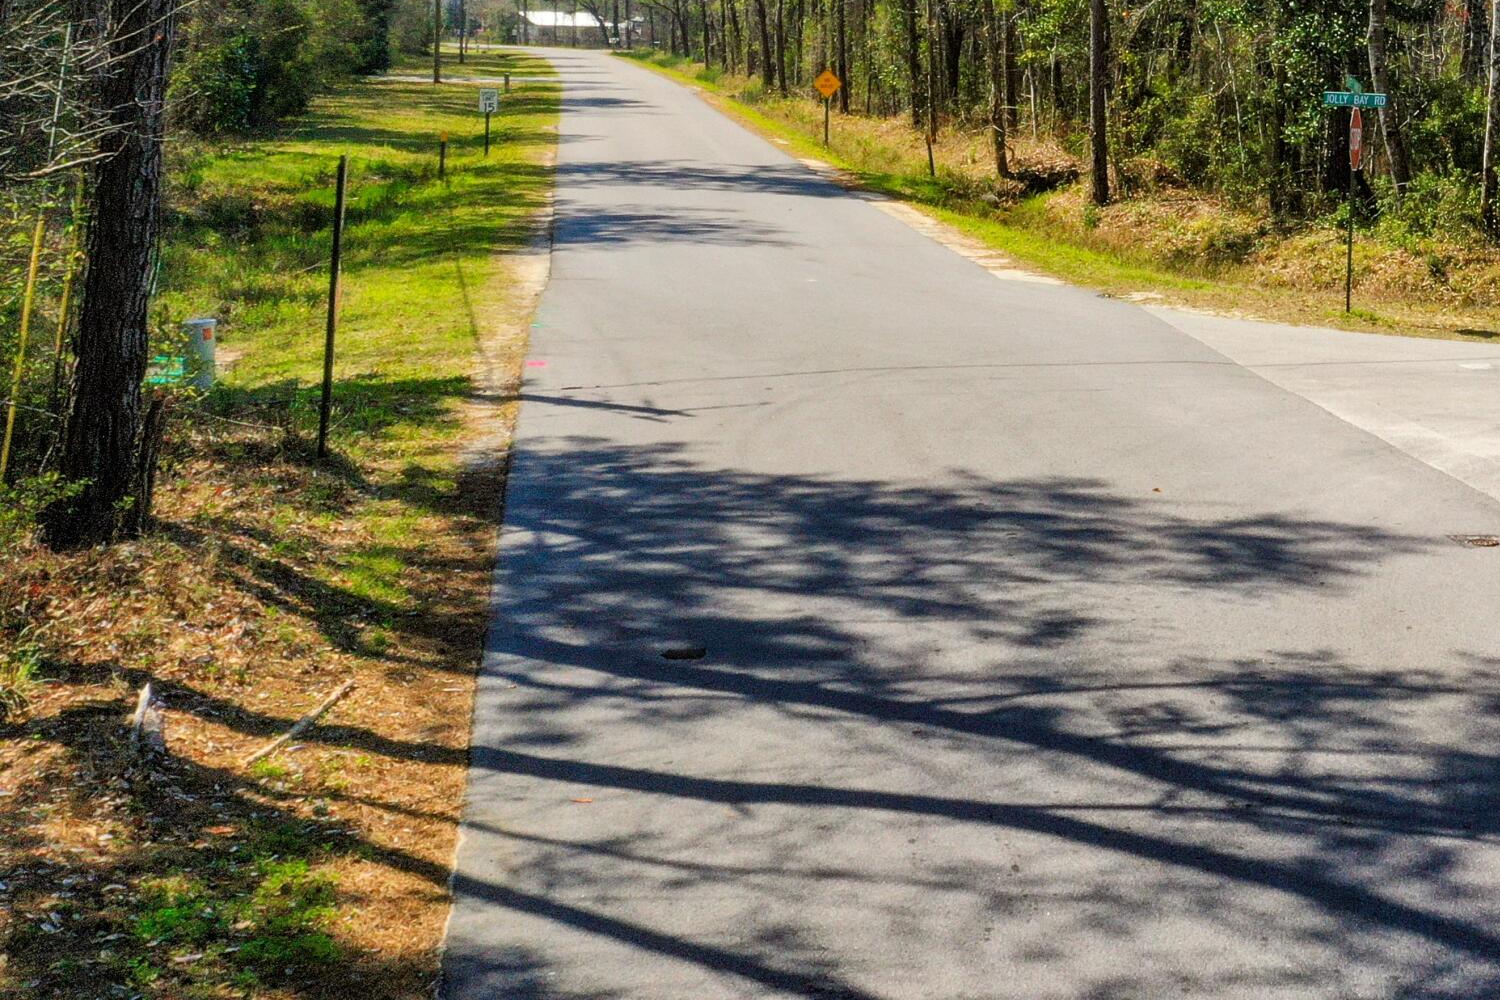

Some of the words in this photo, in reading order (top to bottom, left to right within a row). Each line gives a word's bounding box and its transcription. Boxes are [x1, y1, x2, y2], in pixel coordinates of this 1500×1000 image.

[1325, 94, 1349, 104] JOLLY
[1354, 95, 1369, 105] BAY
[1374, 96, 1386, 106] RD
[484, 102, 495, 113] 15
